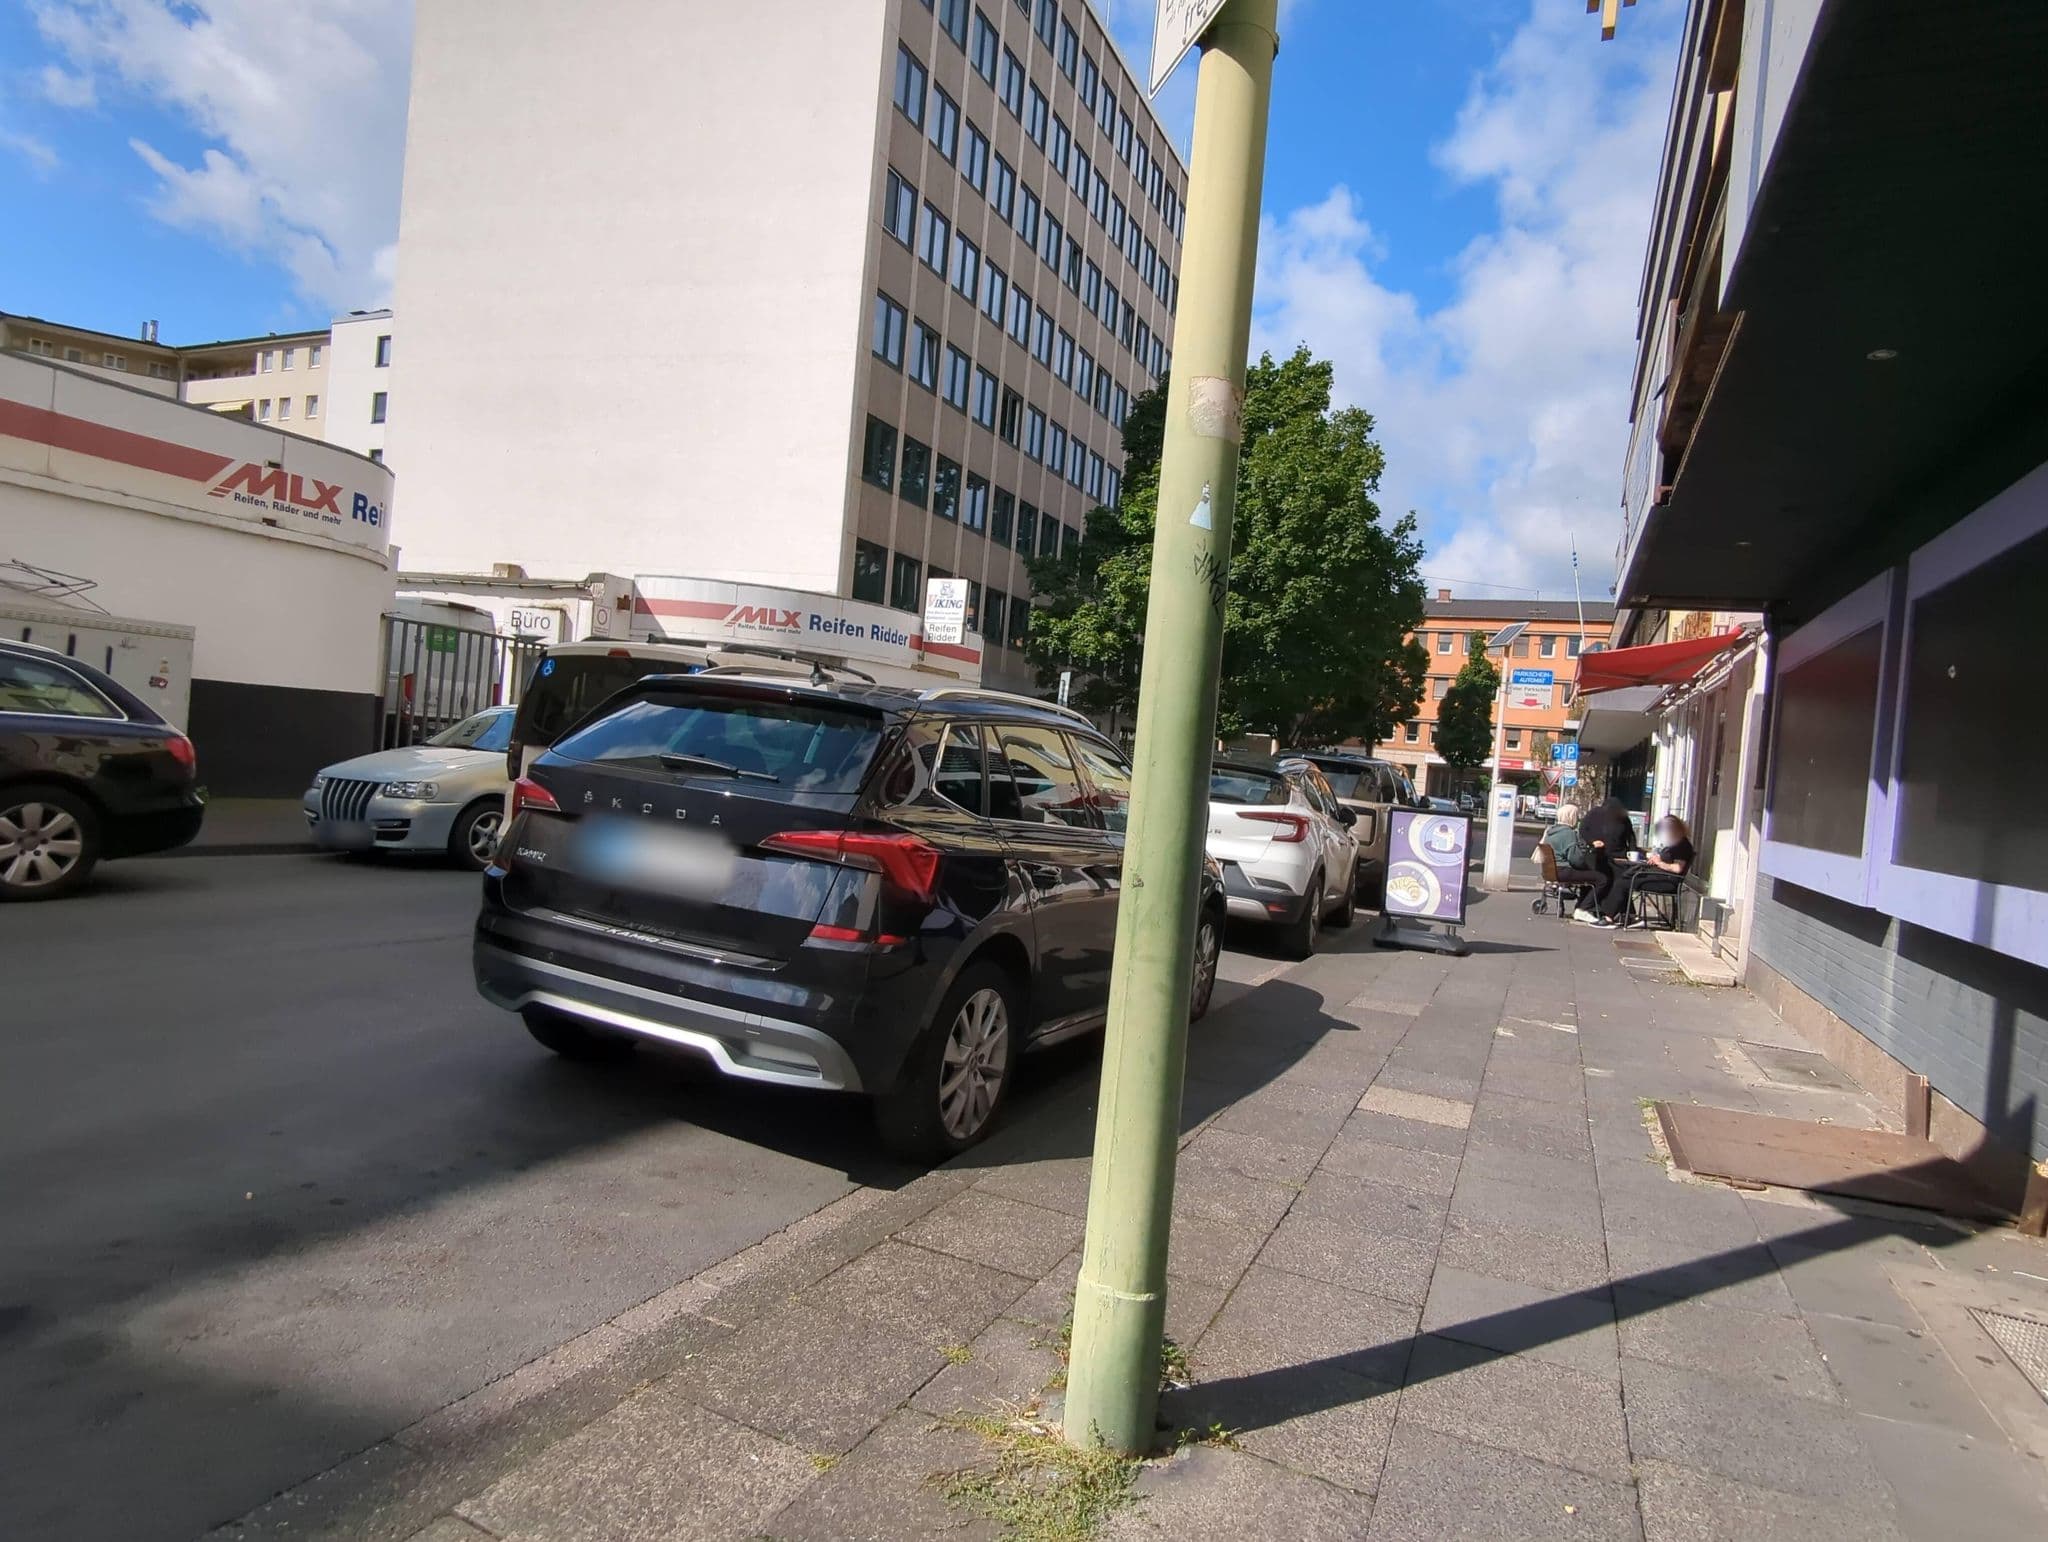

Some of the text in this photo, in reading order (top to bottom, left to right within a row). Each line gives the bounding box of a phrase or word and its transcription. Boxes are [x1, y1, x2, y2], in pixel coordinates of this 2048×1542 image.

[207, 463, 343, 514] MLX
[234, 492, 342, 525] Reifen, Räder und mehr
[928, 594, 963, 608] VIKING
[511, 610, 551, 630] Büro
[724, 606, 801, 628] MLX
[809, 613, 908, 646] Reifen Ridder
[928, 633, 957, 642] Ridder
[929, 624, 957, 633] Reifen
